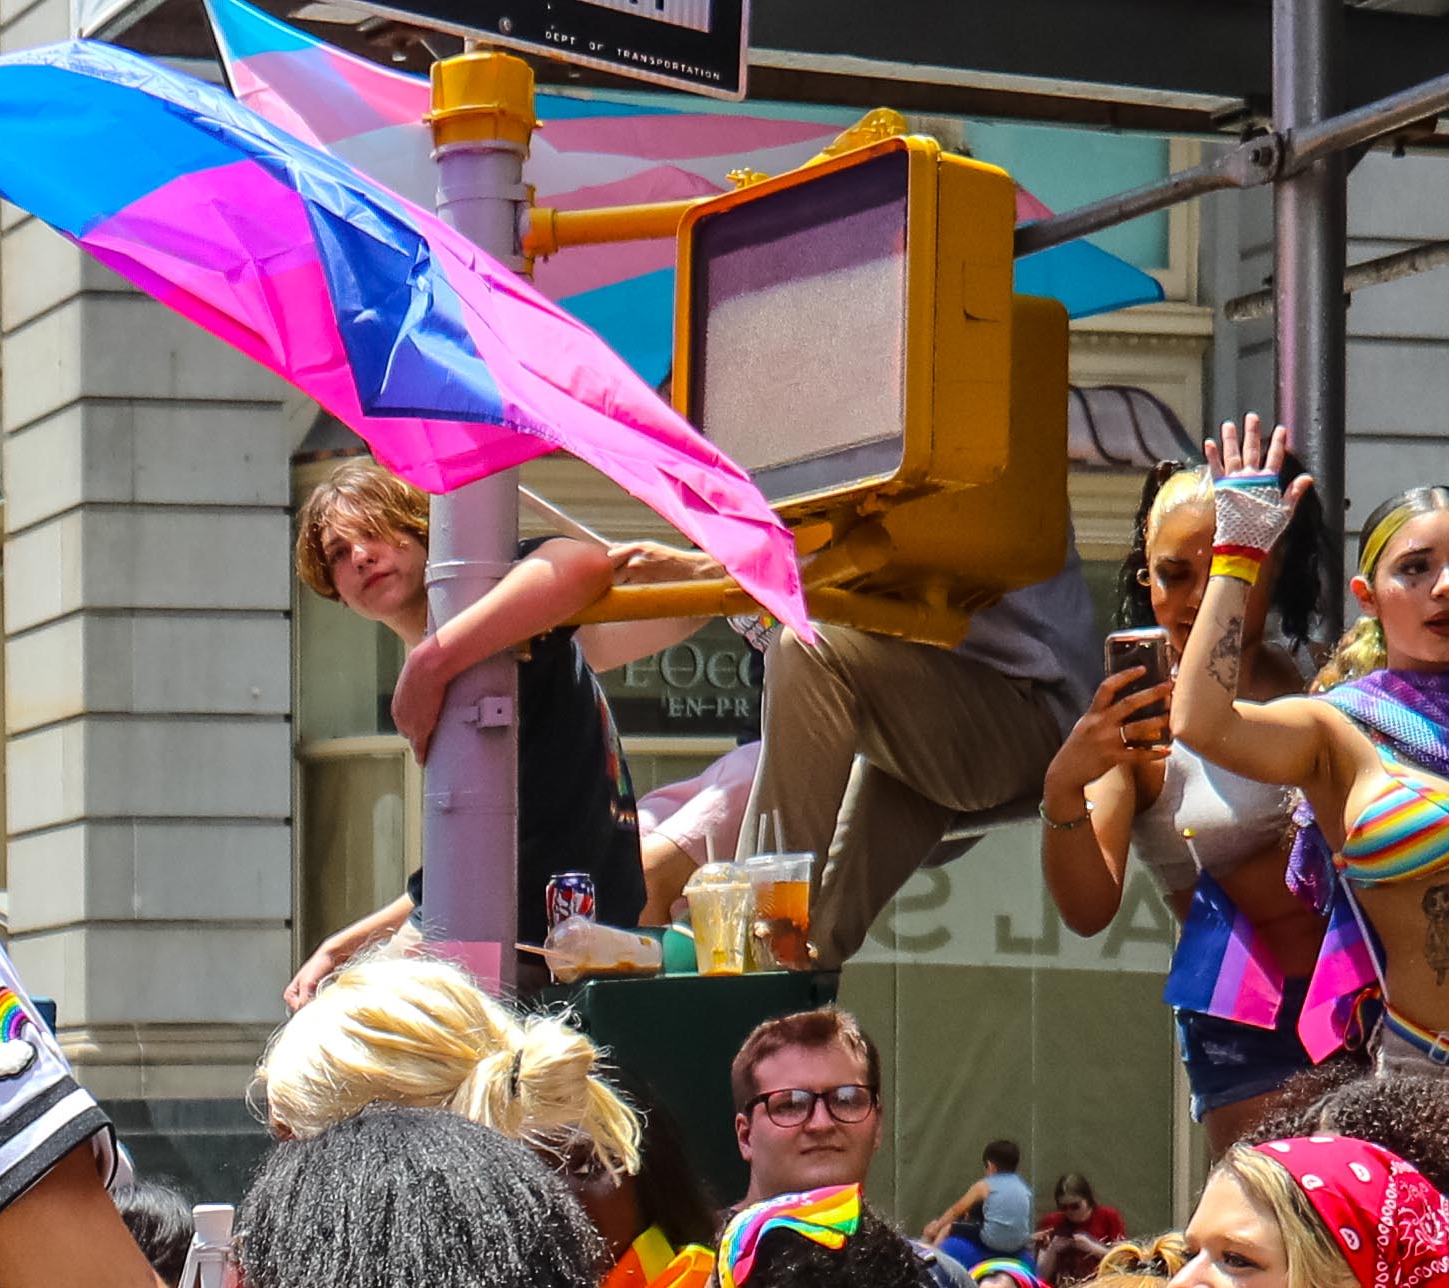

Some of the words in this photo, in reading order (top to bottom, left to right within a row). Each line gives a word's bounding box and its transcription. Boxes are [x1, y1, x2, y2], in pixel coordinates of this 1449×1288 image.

[544, 30, 577, 46] DEPT
[588, 40, 604, 51] OF
[616, 47, 721, 81] TRANSPORTATION
